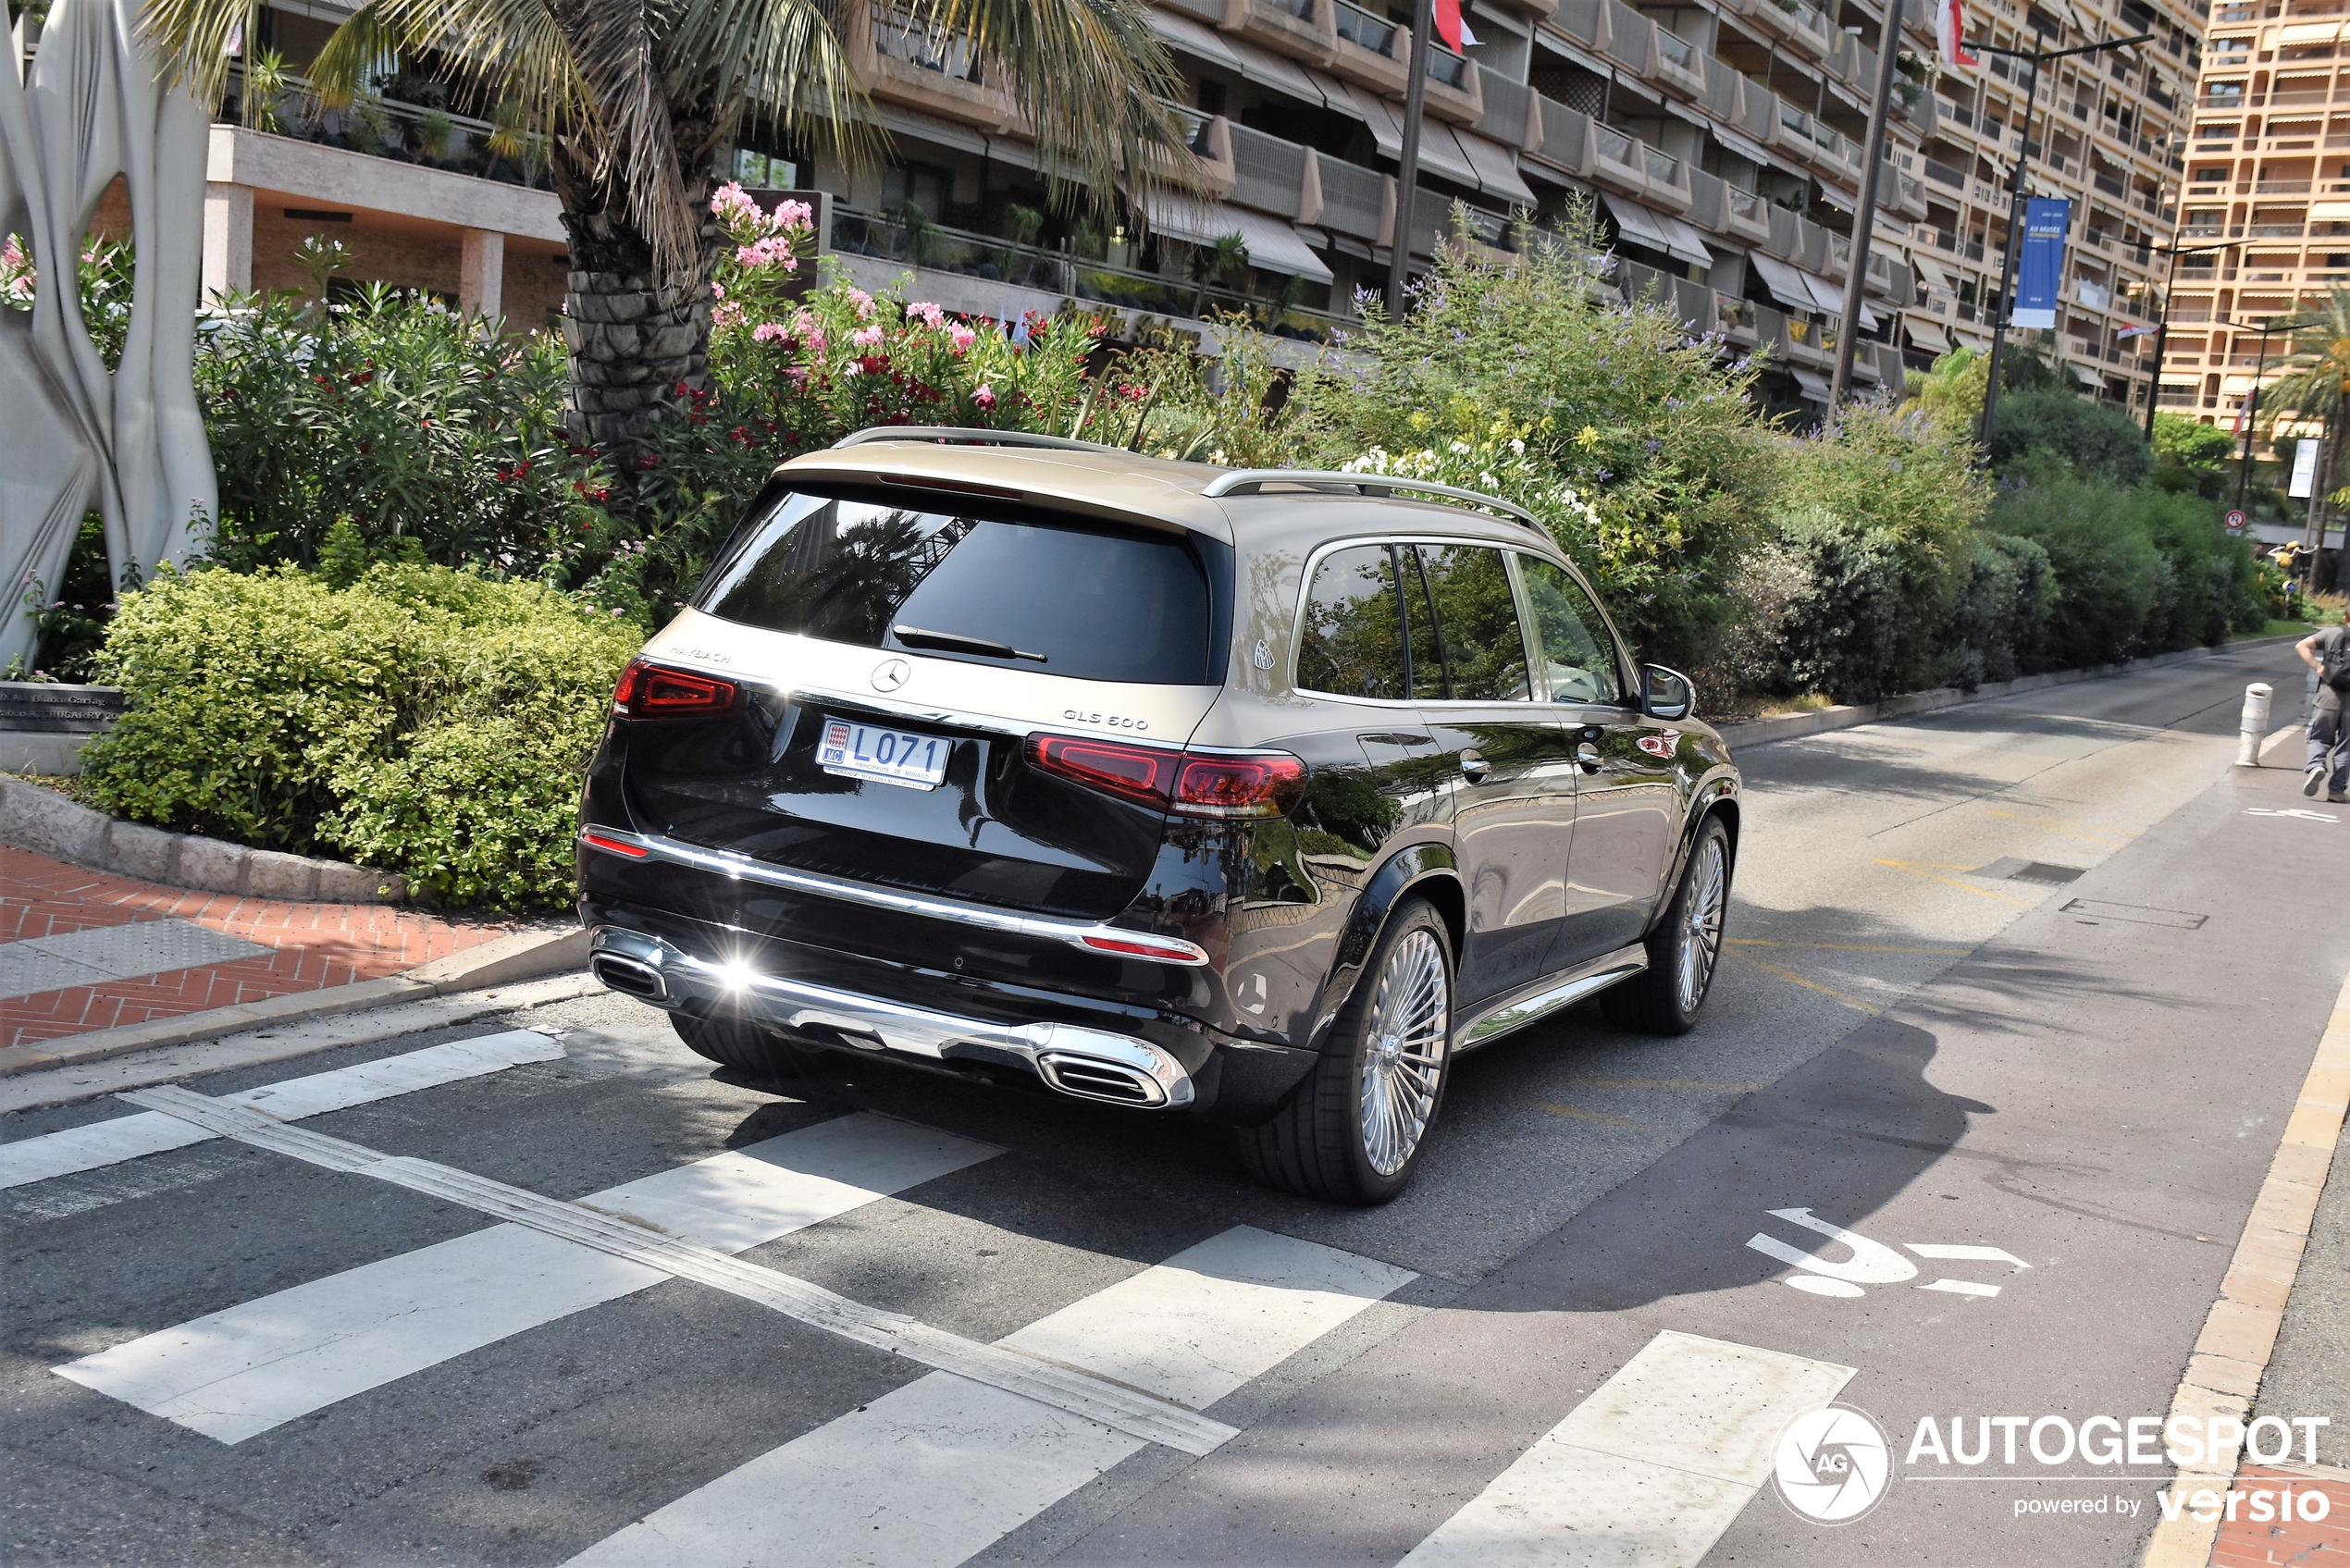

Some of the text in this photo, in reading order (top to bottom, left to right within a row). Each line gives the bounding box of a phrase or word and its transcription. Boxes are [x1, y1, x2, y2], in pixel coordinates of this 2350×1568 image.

[670, 647, 732, 664] MAYBACH
[1062, 710, 1148, 730] GLS 600
[827, 749, 840, 761] MC
[854, 728, 936, 772] L071
[905, 771, 929, 780] MONACO
